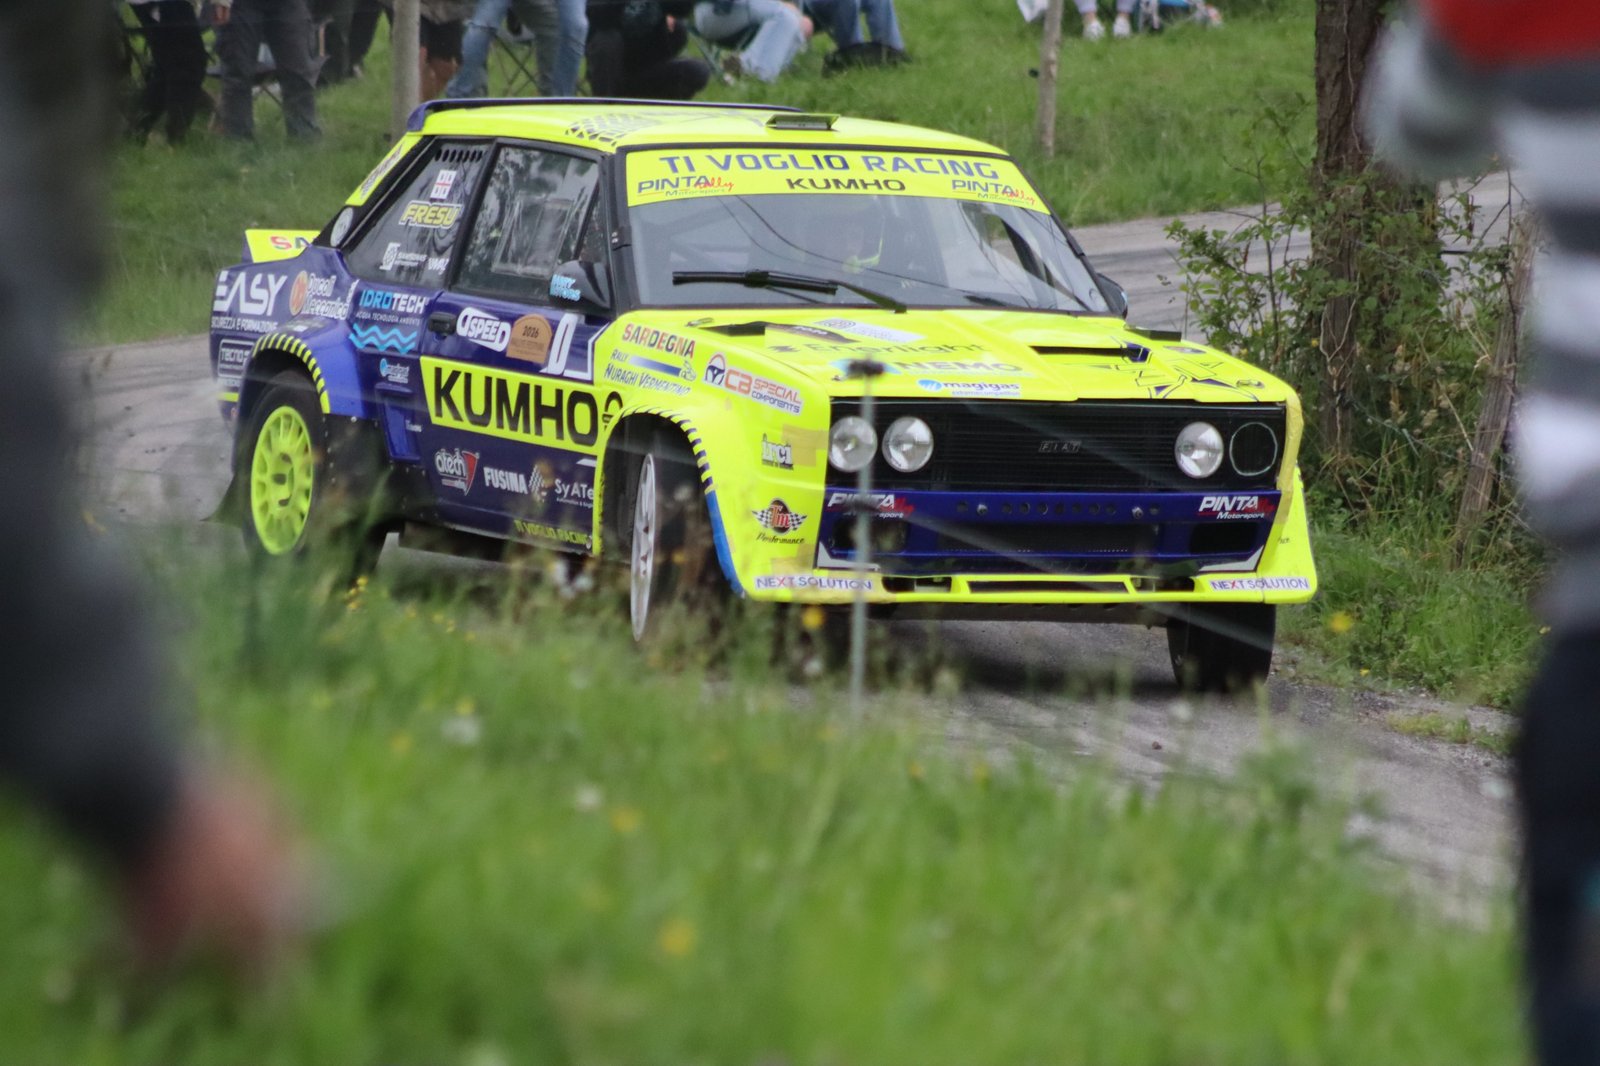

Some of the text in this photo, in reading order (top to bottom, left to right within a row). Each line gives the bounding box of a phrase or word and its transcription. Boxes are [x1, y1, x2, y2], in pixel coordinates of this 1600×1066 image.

[659, 154, 999, 180] TI VOGLIO RACING
[637, 175, 711, 194] PINTA
[785, 178, 906, 192] KUMHO
[951, 179, 1017, 196] PINTA
[401, 203, 462, 227] FRESU
[212, 269, 288, 317] EASY
[359, 289, 426, 315] IDROTECH
[622, 323, 696, 359] SARDEGNA
[610, 348, 629, 363] RALLY
[434, 366, 599, 447] KUMHO
[1038, 440, 1082, 453] FIAT
[483, 466, 528, 495] FUSINA
[1199, 496, 1259, 512] PINTA
[1216, 511, 1265, 520] Motorsport
[756, 576, 872, 590] NEXT SOLUTION
[1211, 578, 1309, 591] NEXT SOLUTION
